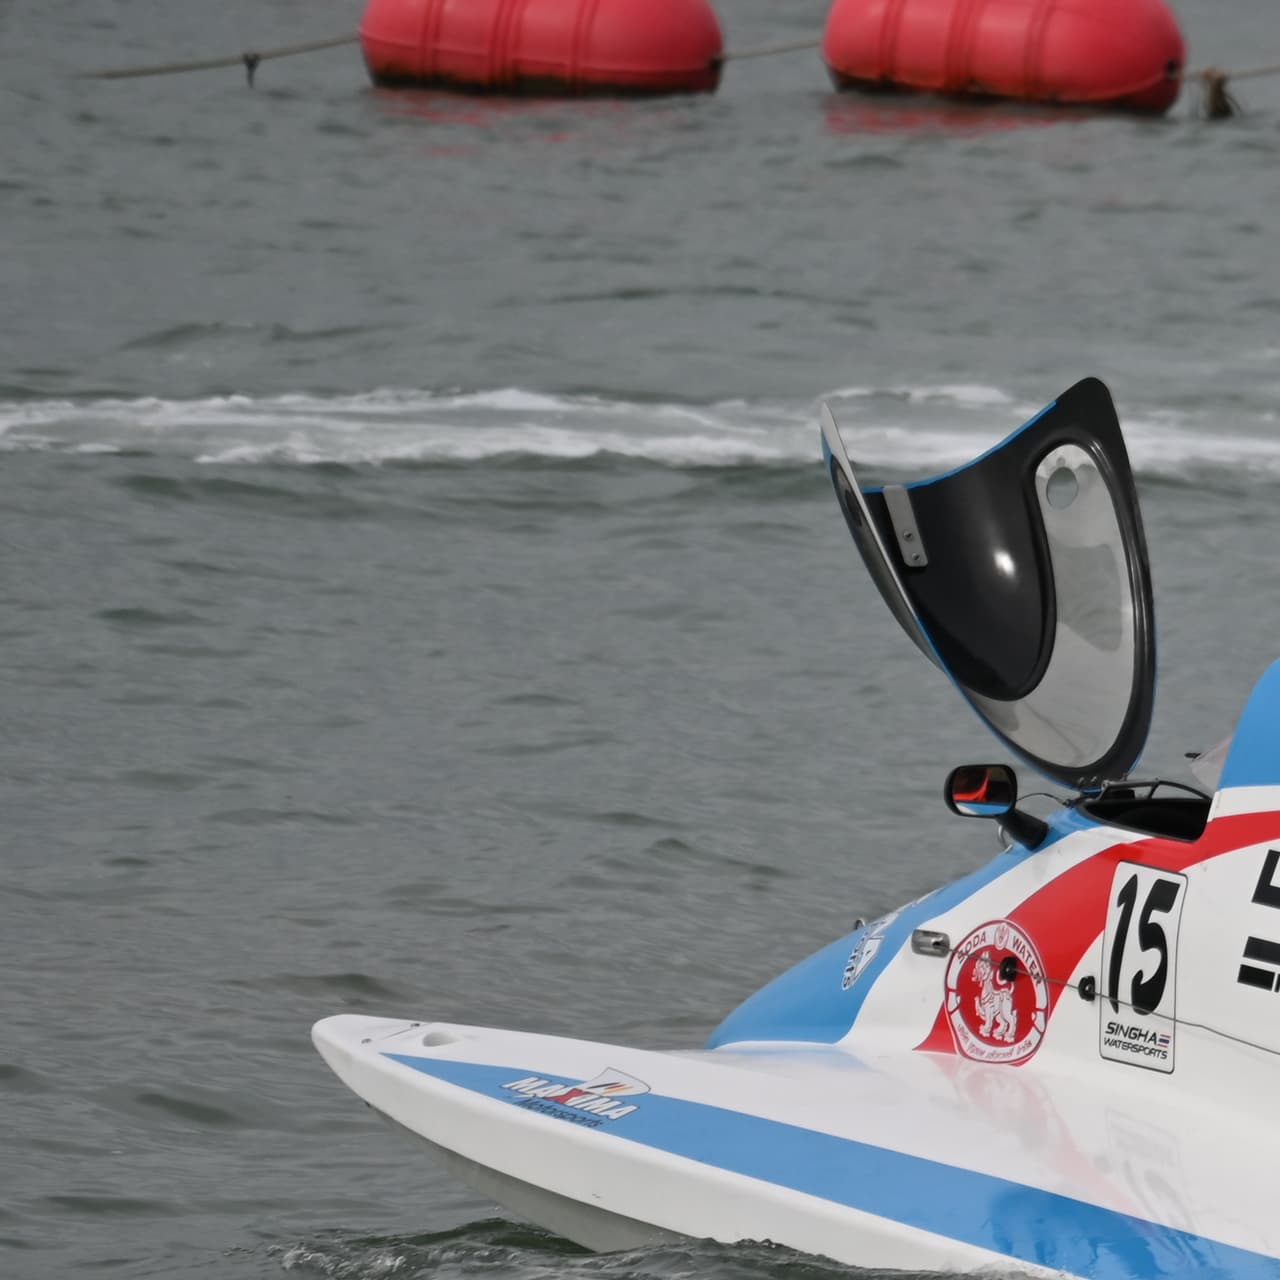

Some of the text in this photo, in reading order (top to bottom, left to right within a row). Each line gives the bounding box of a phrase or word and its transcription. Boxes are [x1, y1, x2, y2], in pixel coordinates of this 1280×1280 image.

[957, 931, 1044, 985] SODA WATER
[1108, 873, 1181, 1016] 15
[1103, 1036, 1168, 1060] WATERSPORTS
[1105, 1020, 1158, 1046] SINGHA
[500, 1076, 640, 1120] MAXIMA
